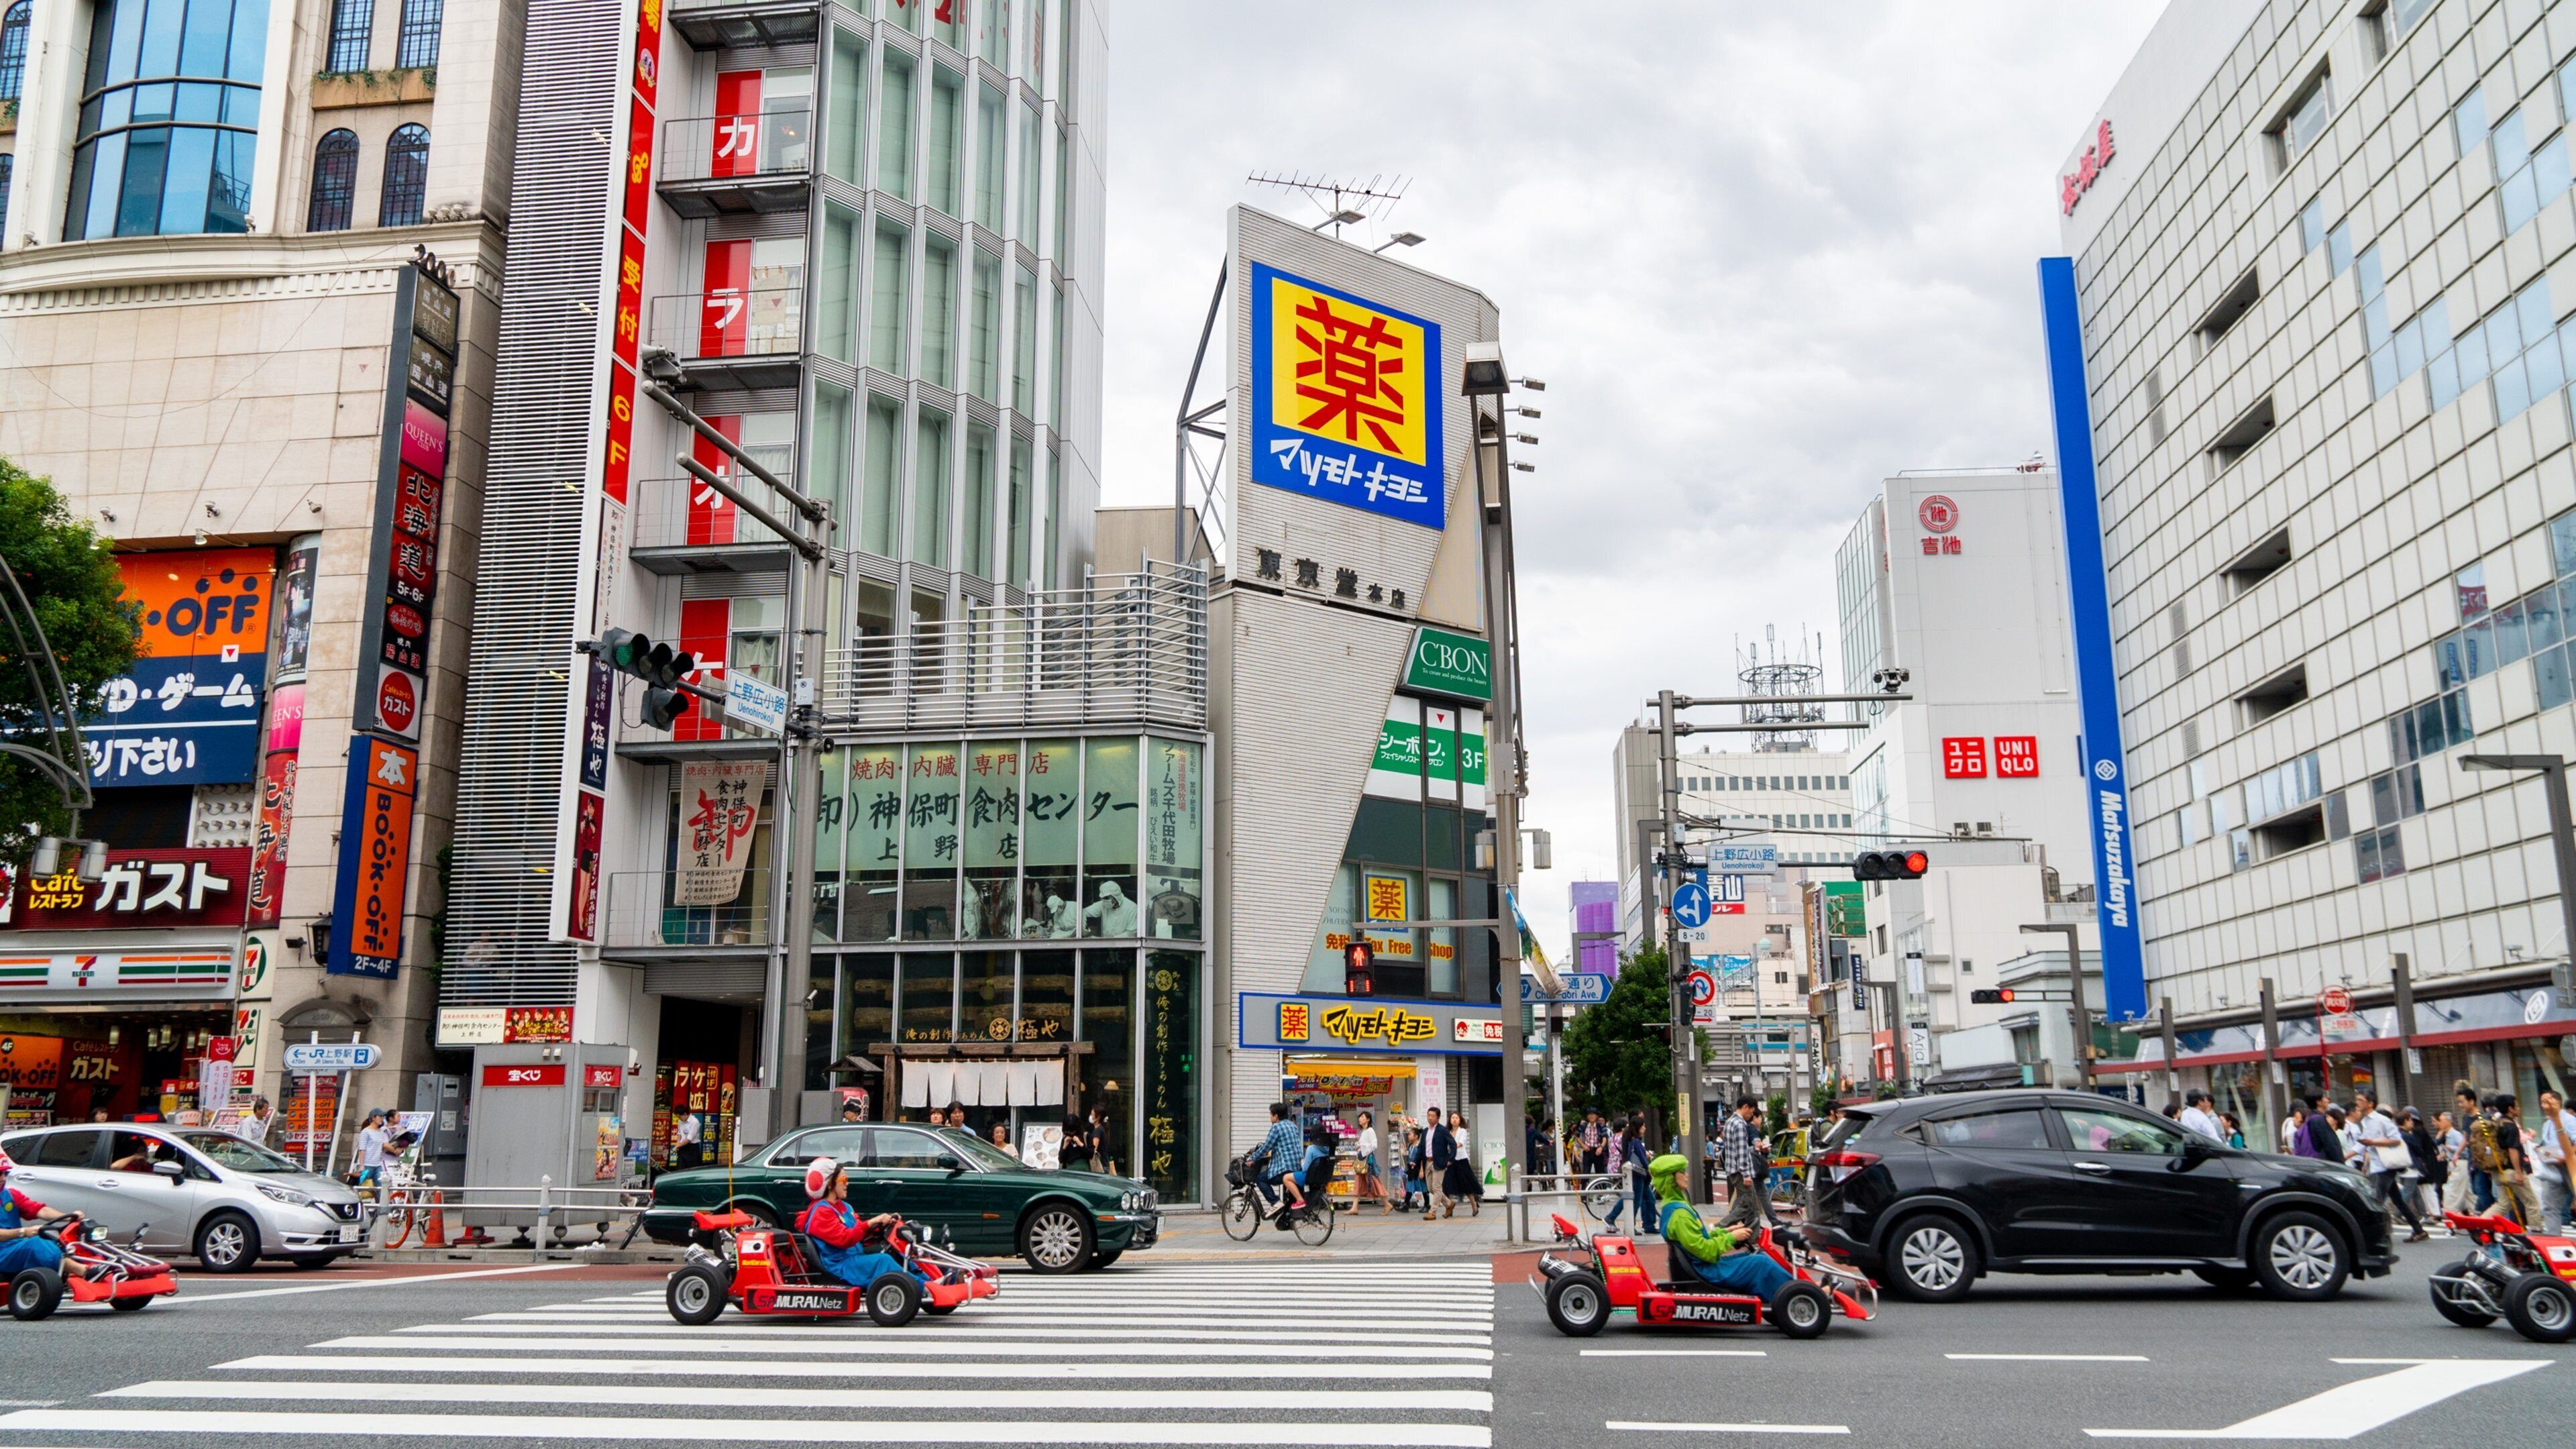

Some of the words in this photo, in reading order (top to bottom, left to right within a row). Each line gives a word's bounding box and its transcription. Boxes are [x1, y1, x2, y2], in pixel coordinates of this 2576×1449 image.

[620, 254, 641, 344] 受付
[1296, 295, 1404, 455] 薬
[405, 422, 443, 453] QUEEN'S
[1270, 437, 1428, 504] マツモトキヨシ
[398, 472, 432, 581] 北海道
[1921, 535, 1963, 555] 吉池
[1419, 641, 1488, 677] C'BON
[383, 695, 411, 716] ガスト
[730, 677, 787, 714] 上野広小路
[374, 716, 382, 727] B1
[737, 701, 775, 725] Uenohirokoji
[1462, 748, 1483, 769] 3F
[2000, 740, 2031, 755] UNI
[377, 749, 407, 786] 本
[852, 752, 1049, 781] 焼肉・内臓専門店
[1177, 745, 1187, 812] 北海道提携牧場
[2000, 757, 2035, 773] QLO
[276, 760, 296, 862] 北の味紀行と地酒
[731, 779, 748, 828] 神保町
[1149, 787, 1158, 807] 銘柄
[1161, 741, 1176, 865] ファームズ千代田牧場
[714, 779, 731, 867] 食肉センター
[695, 820, 712, 868] 上野店
[876, 832, 1018, 862] 上野店
[1149, 816, 1158, 863] びえい和牛
[1711, 849, 1774, 861] 上野広小路
[591, 852, 599, 886] ワイン
[2100, 790, 2131, 928] Matsuzakaya
[95, 860, 229, 912] ガスト
[1373, 880, 1401, 919] 薬
[1707, 874, 1742, 901] 青山
[29, 894, 84, 910] レストラン
[1388, 938, 1412, 955] Free
[1580, 991, 1599, 1000] Ave.
[1283, 1006, 1307, 1038] 薬
[1325, 1006, 1436, 1042] マツモトキヨシ
[1, 1041, 13, 1051] 4F
[309, 1049, 352, 1059] JR上野駅
[1156, 995, 1171, 1109] 俺の創作らあめん
[70, 1056, 119, 1080] ガスト
[508, 1069, 541, 1082] 宝くじ
[594, 1070, 612, 1083] 宝くじ
